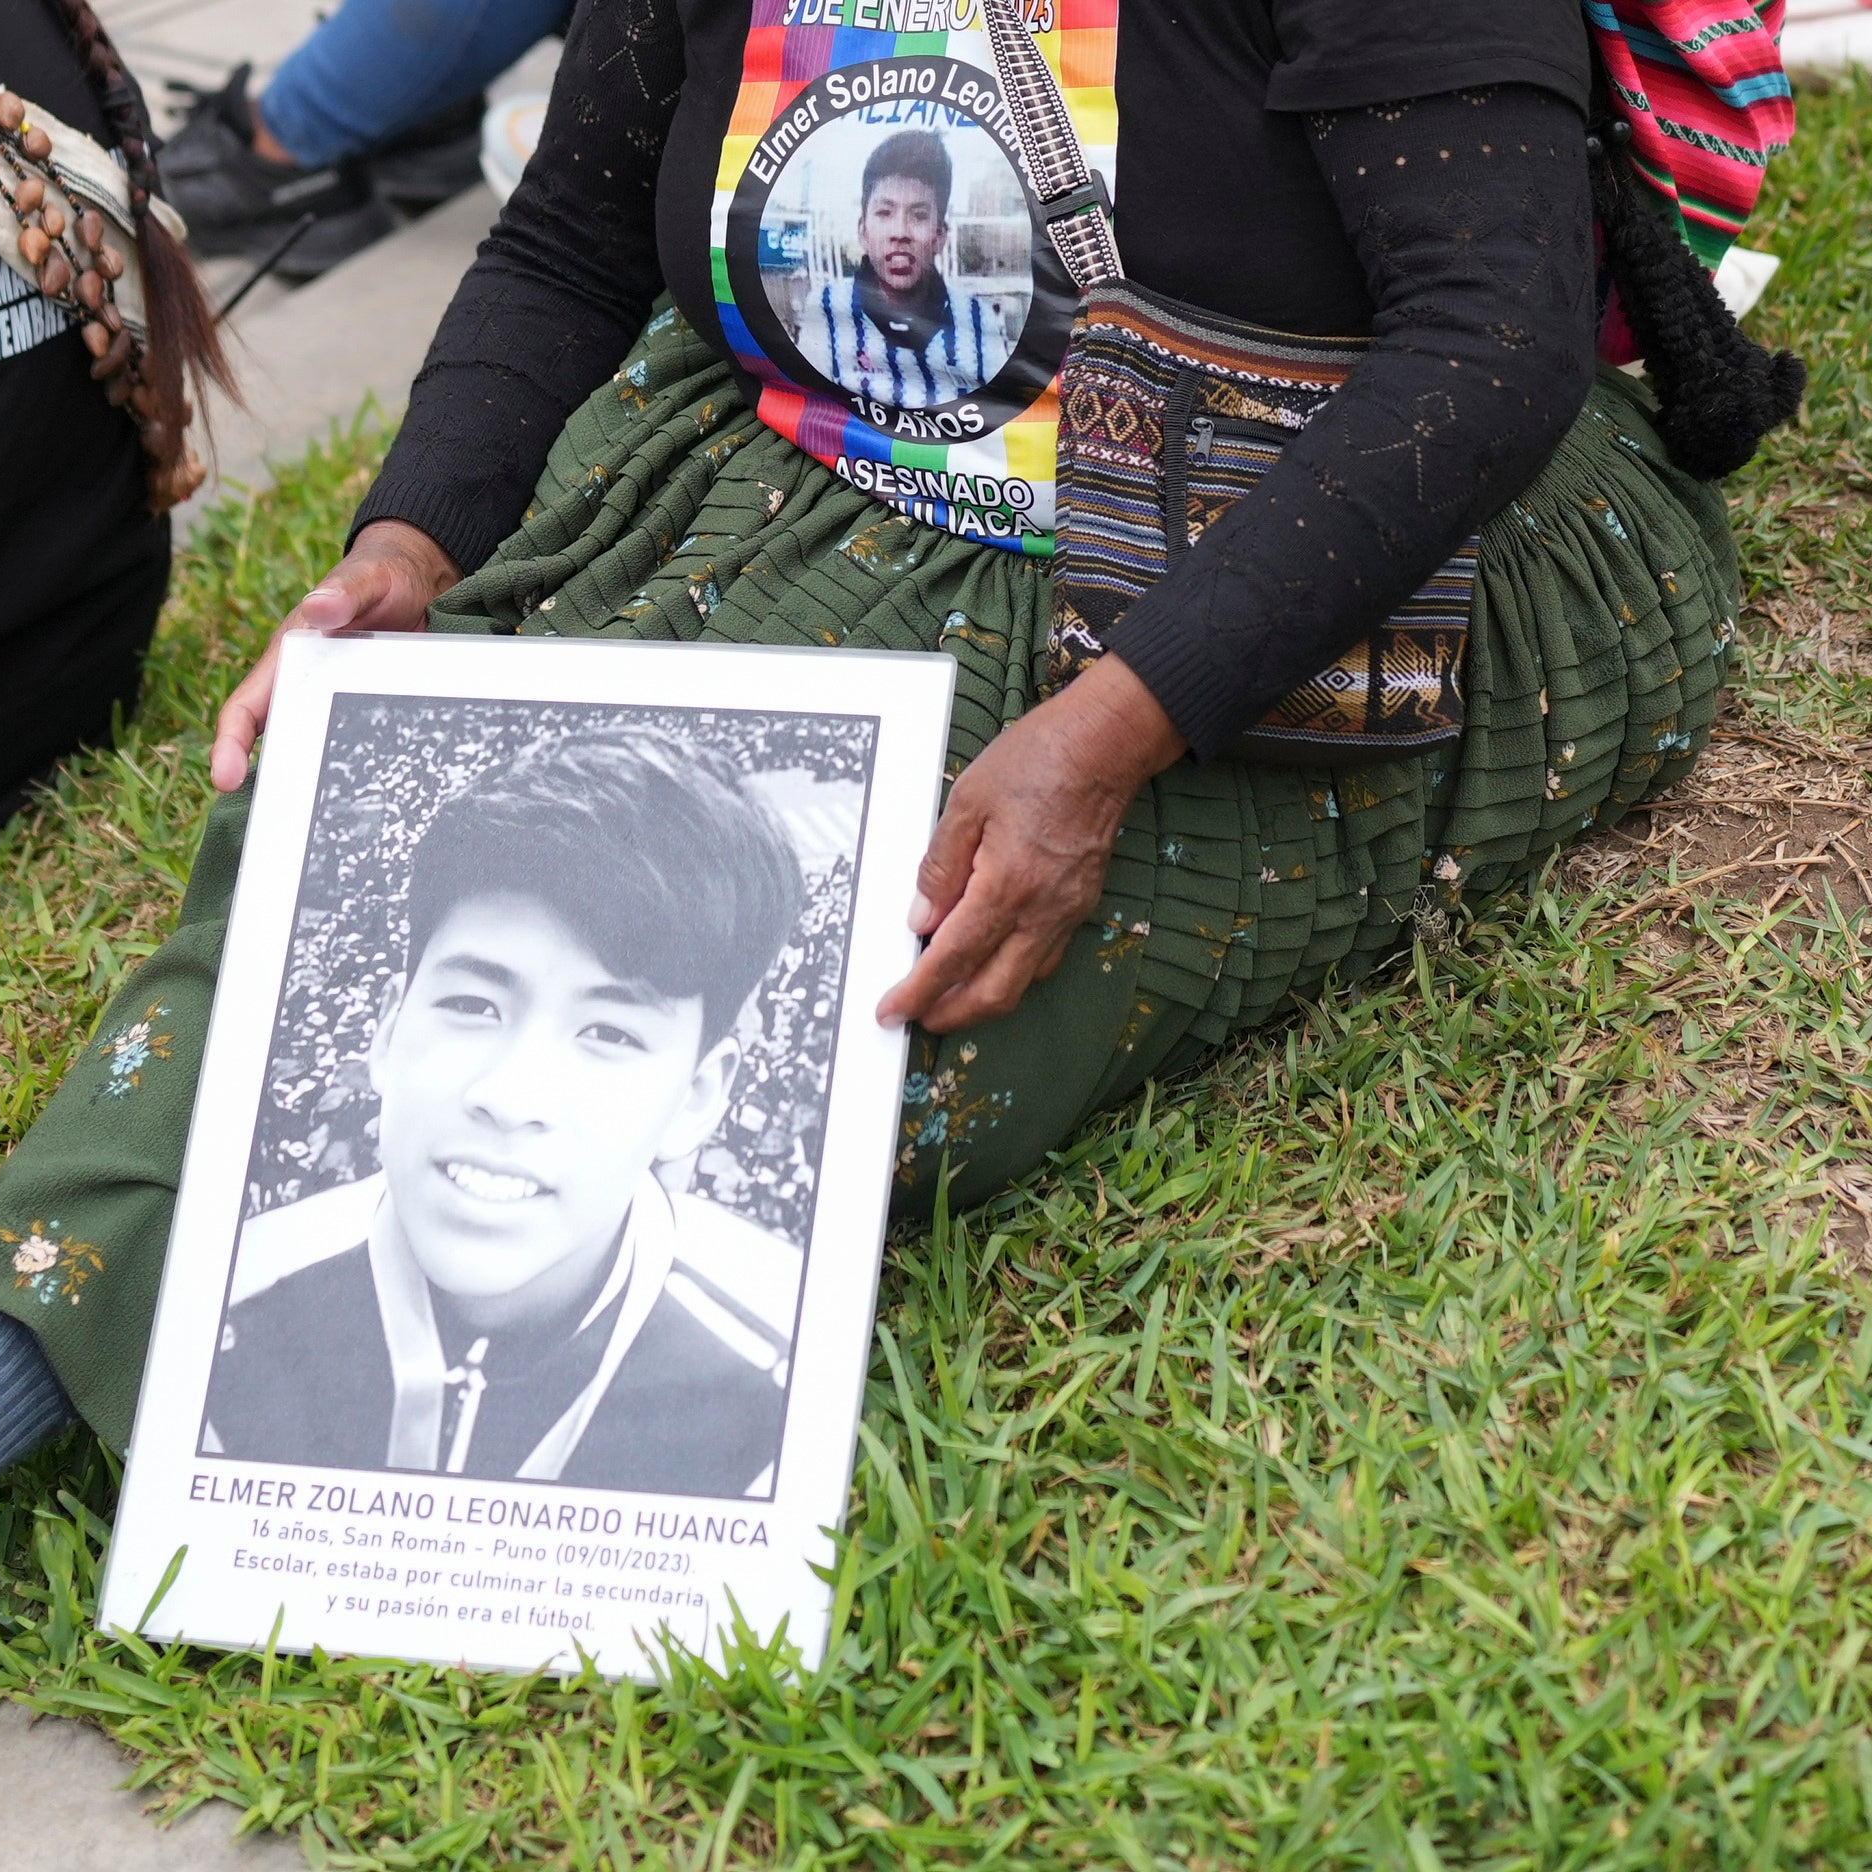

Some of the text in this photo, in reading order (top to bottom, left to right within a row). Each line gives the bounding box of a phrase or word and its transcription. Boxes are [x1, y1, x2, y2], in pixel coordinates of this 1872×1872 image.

[747, 94, 820, 185] Elmer
[826, 64, 936, 110] Solano
[851, 396, 985, 439] 16 AÑOS
[835, 455, 1035, 511] ASESINADO
[189, 1474, 769, 1547] ELMER ZOLANO LEONARDO HUANCA
[233, 1549, 318, 1577] Escolar,
[326, 1561, 398, 1582] estaba
[405, 1571, 442, 1588] por
[450, 1569, 547, 1594] culminar
[555, 1576, 573, 1597] la
[251, 1518, 270, 1538] 16
[278, 1521, 334, 1546] años,
[342, 1527, 383, 1548] San
[391, 1530, 466, 1555] Román
[492, 1539, 547, 1561] Puno
[556, 1542, 695, 1576] (09/01/2023).
[326, 1594, 596, 1631] y su pasión era el fútbol.
